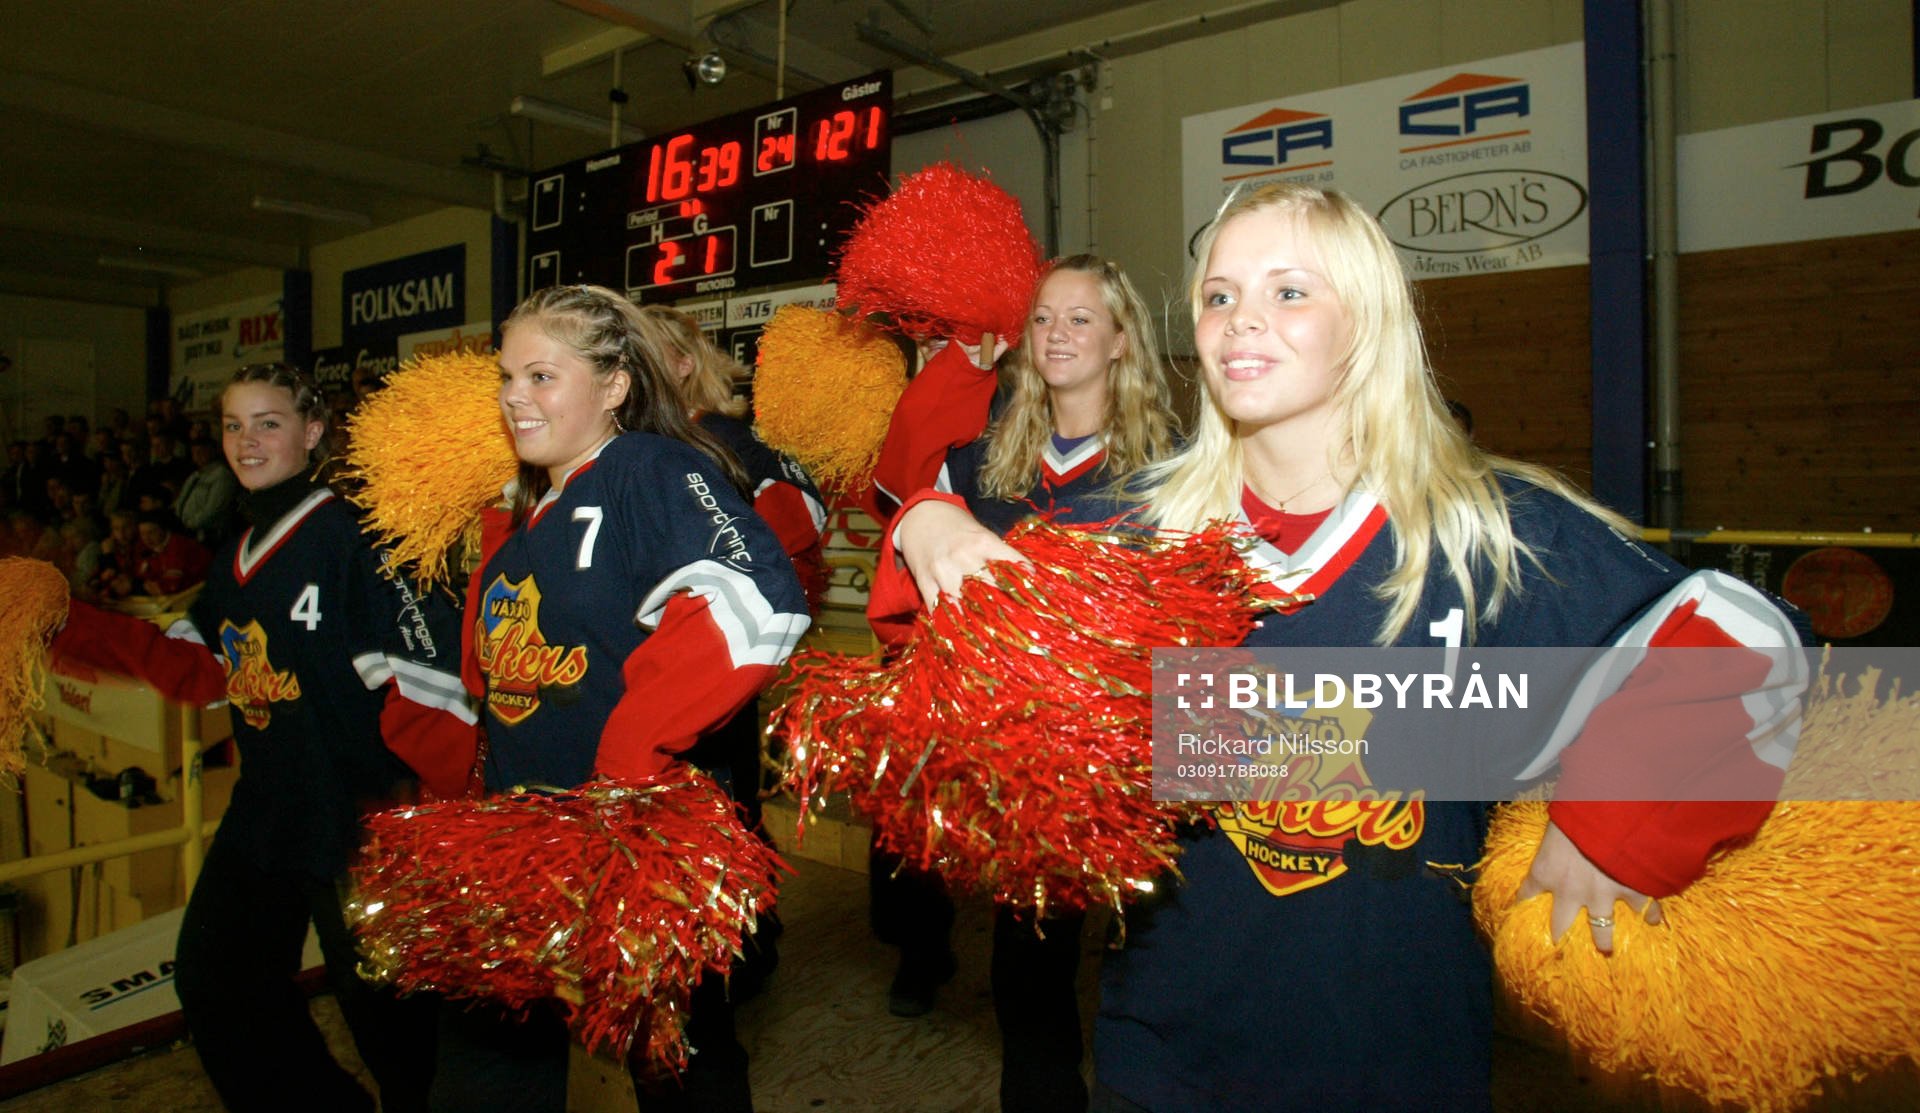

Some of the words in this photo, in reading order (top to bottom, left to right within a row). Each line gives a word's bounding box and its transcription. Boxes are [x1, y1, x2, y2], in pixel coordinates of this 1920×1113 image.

[841, 81, 882, 101] Gäster
[767, 116, 783, 131] Nr
[1399, 84, 1531, 137] CA
[757, 133, 795, 172] 24
[1221, 118, 1333, 166] CA
[1400, 158, 1418, 171] CA
[1420, 143, 1509, 169] FASTIGHETER
[1513, 140, 1532, 153] AB
[763, 206, 781, 222] Nr
[1464, 253, 1509, 272] Wear
[1515, 243, 1544, 265] AB
[351, 272, 454, 326] FOLKSAM
[239, 312, 280, 347] RIX
[314, 356, 349, 382] Grace
[570, 505, 604, 569] 7
[290, 584, 322, 632] 4
[1429, 608, 1465, 694] 1
[1247, 841, 1333, 874] HOCKEY
